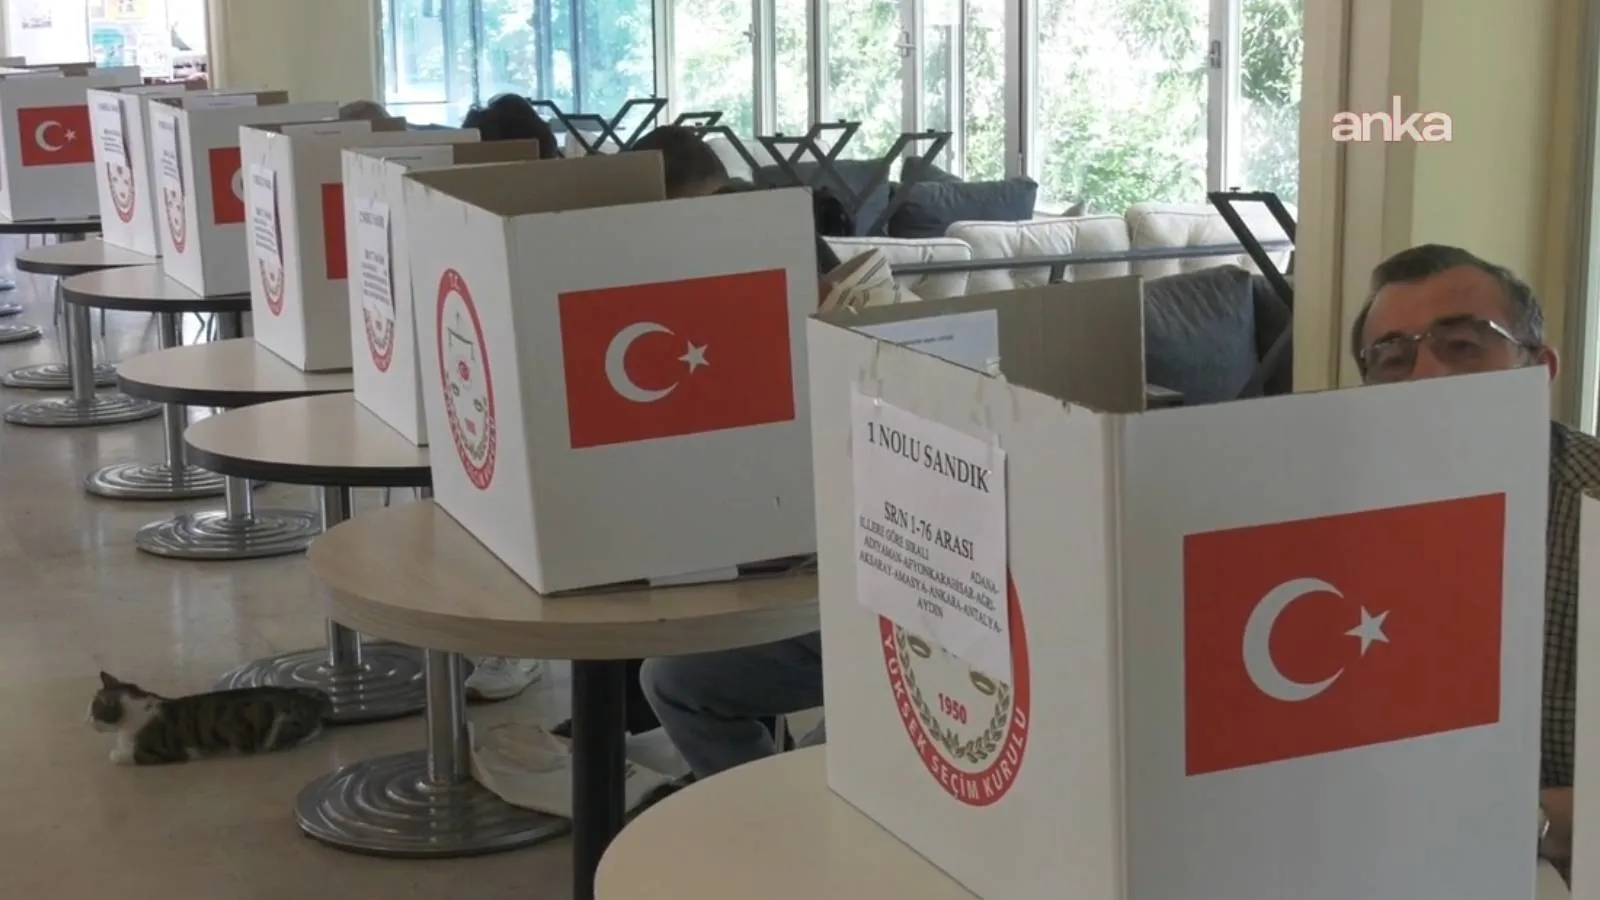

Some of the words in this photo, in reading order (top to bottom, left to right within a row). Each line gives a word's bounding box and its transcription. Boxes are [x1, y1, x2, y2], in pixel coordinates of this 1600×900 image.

[868, 421, 875, 443] 1
[879, 423, 921, 463] NOLU
[924, 444, 989, 493] SANDIK
[911, 515, 932, 541] 1-76
[934, 527, 974, 561] ARASI
[938, 692, 968, 725] 1950
[931, 754, 979, 801] SEÇİM
[984, 707, 1026, 798] KURULU
